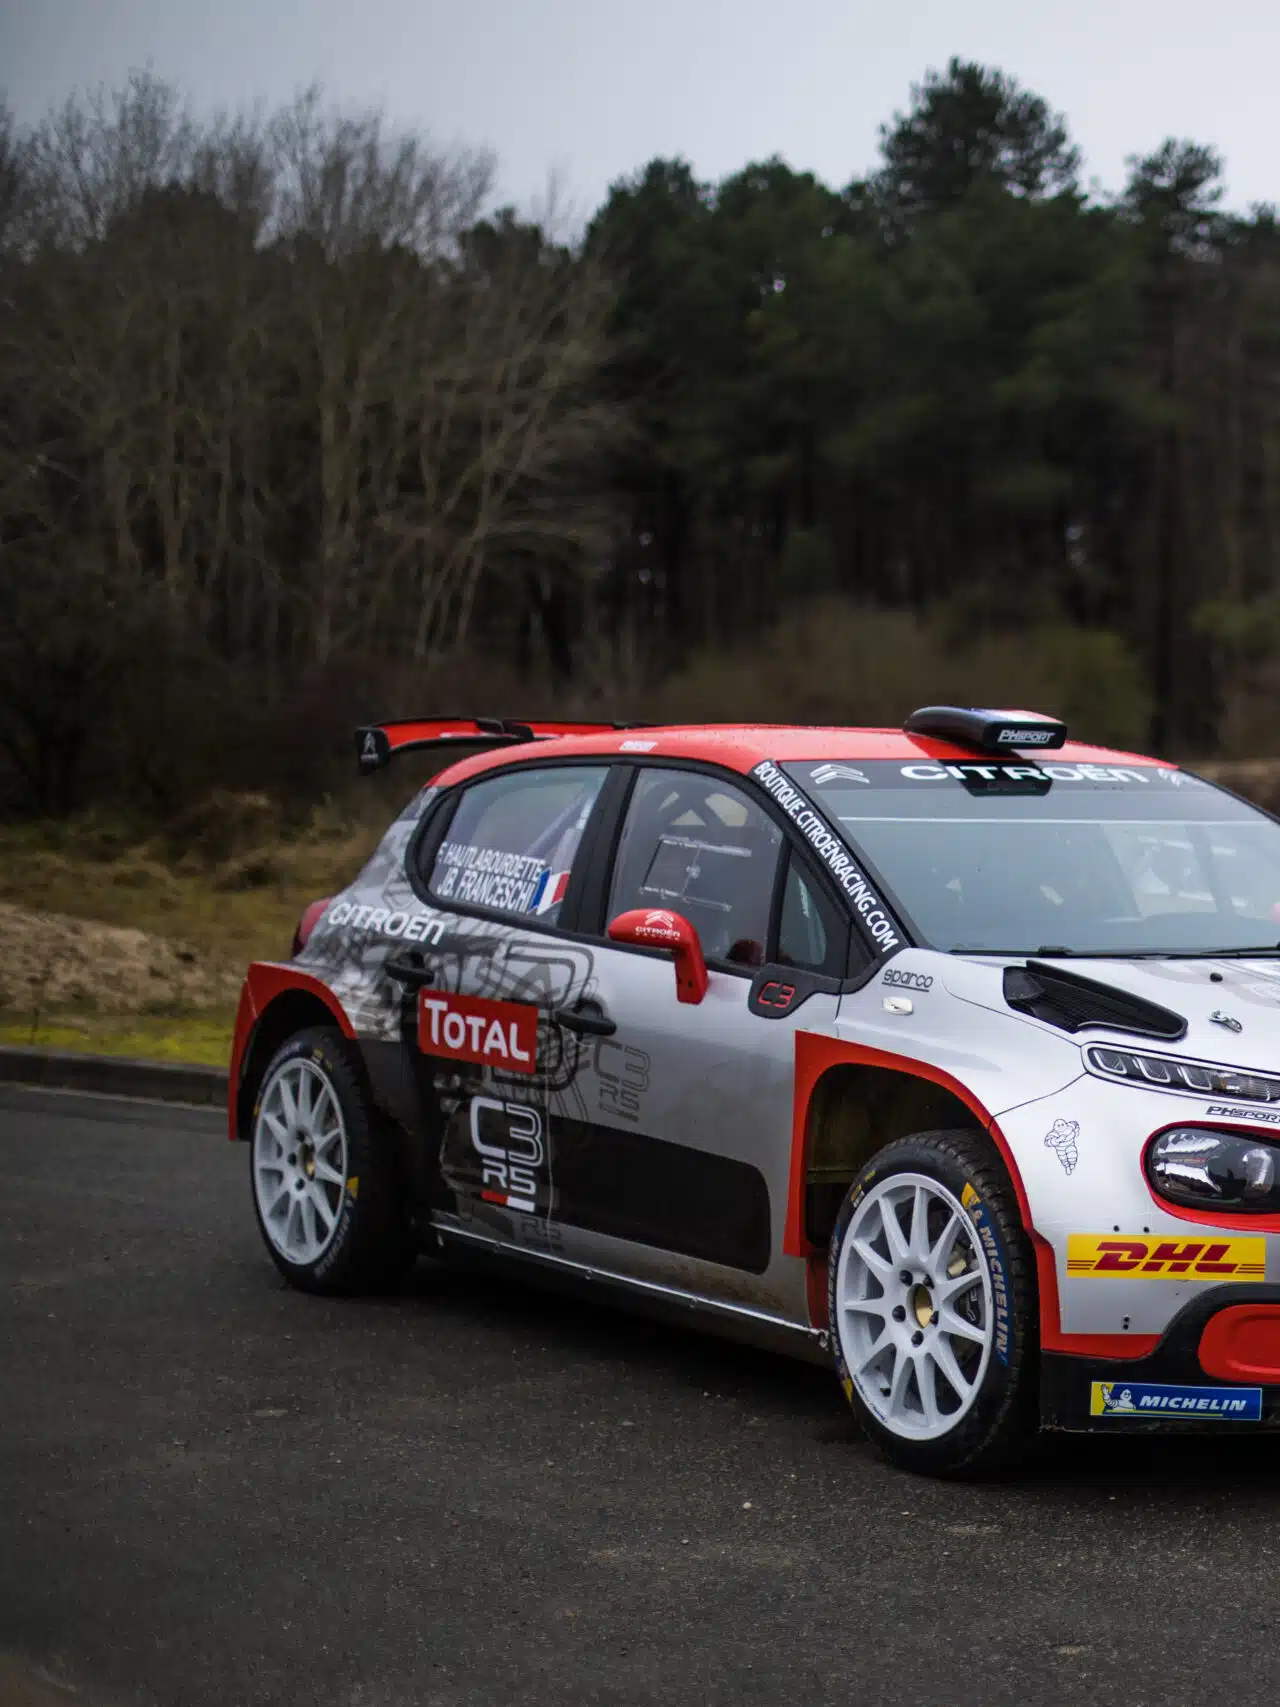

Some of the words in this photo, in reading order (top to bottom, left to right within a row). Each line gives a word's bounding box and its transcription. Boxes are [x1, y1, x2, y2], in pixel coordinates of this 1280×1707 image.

[998, 729, 1054, 744] PHSPORT
[900, 763, 1149, 783] CITROËN
[754, 761, 899, 952] BOUTIQUE.CITROËNRACING.COM
[454, 869, 536, 913] FRANCESCHI
[759, 981, 795, 1008] C3
[884, 968, 934, 990] sparco
[424, 998, 530, 1062] TOTAL
[470, 1096, 543, 1167] C3
[482, 1158, 536, 1195] R5
[1094, 1241, 1239, 1273] DHL
[980, 1226, 1008, 1354] MICHELIN
[1139, 1395, 1246, 1412] MICHELIN
